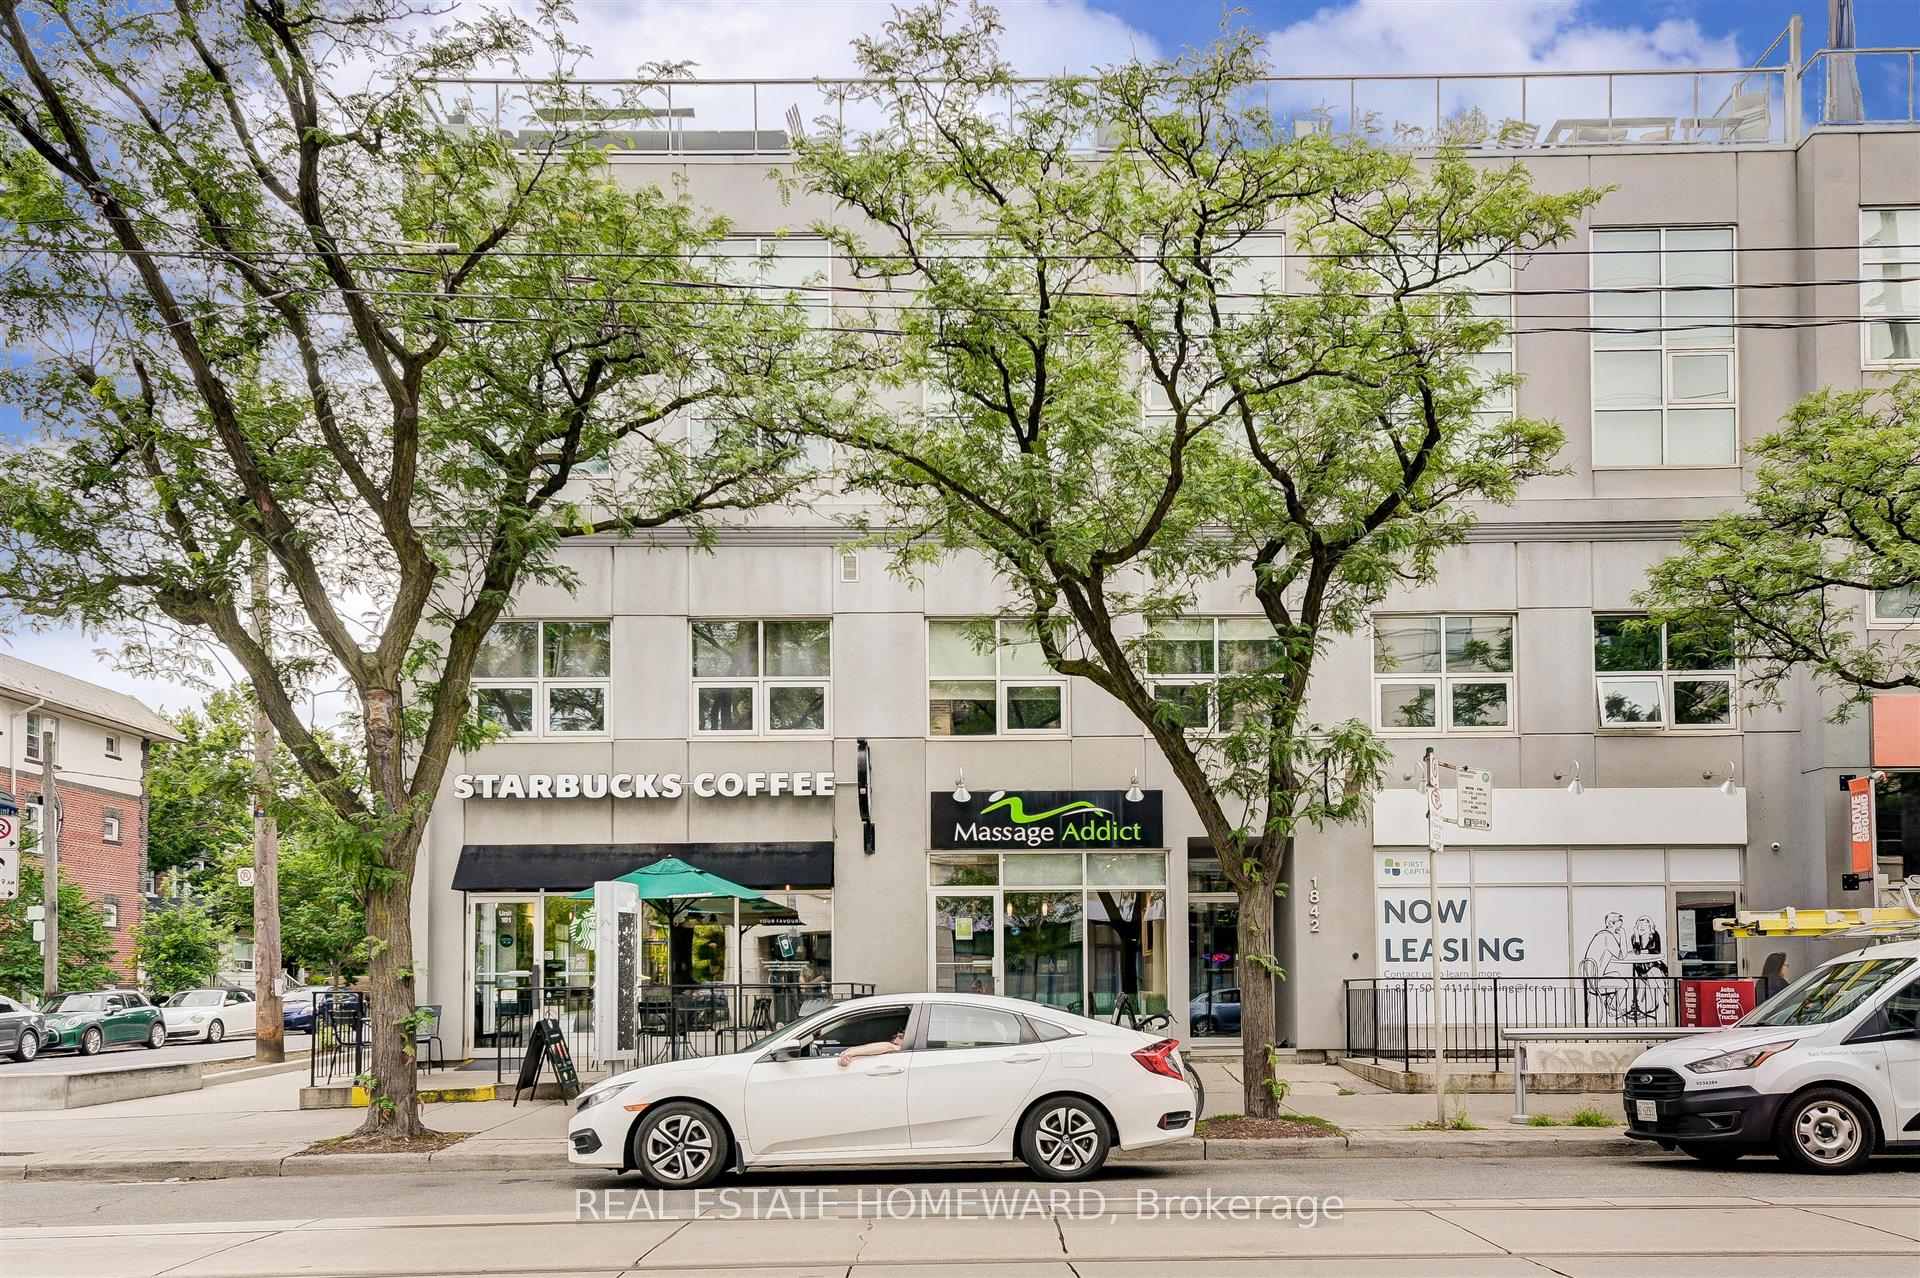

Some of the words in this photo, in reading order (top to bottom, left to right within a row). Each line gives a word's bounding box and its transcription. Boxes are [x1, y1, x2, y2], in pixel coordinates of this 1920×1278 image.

[453, 773, 683, 800] STARBUCKS
[693, 771, 836, 798] COFFEE
[1851, 794, 1863, 842] ABOVE
[1861, 793, 1870, 842] GROUND
[954, 822, 1055, 847] Massage
[1062, 819, 1142, 841] Addict
[1403, 860, 1425, 868] FIRST
[1309, 876, 1320, 934] 1842
[1384, 899, 1467, 924] NOW
[1384, 937, 1525, 962] LEASING
[1383, 969, 1418, 979] Contact
